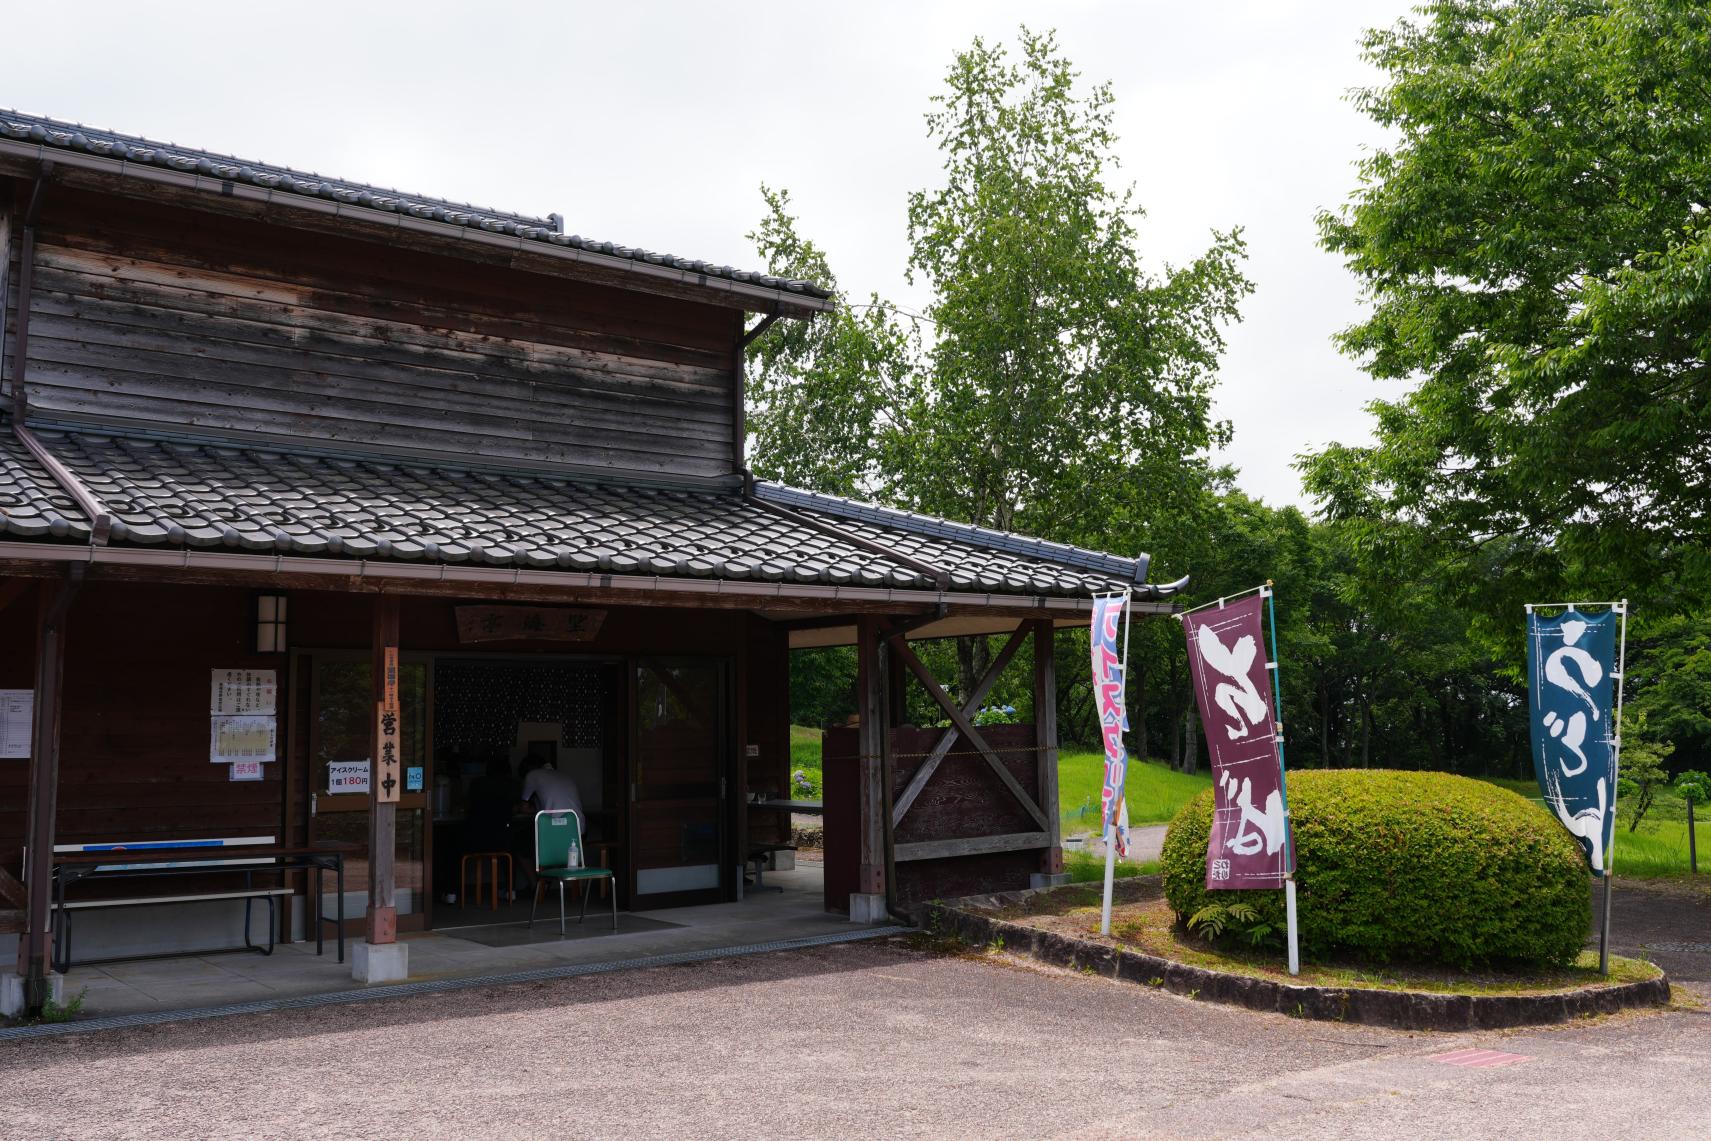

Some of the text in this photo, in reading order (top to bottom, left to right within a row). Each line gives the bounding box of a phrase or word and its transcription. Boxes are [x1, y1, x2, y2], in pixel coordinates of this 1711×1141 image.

[381, 712, 397, 799] 営業中
[235, 762, 258, 775] 禁煙
[330, 766, 368, 774] アイスクリーム
[331, 776, 368, 786] 1個180円
